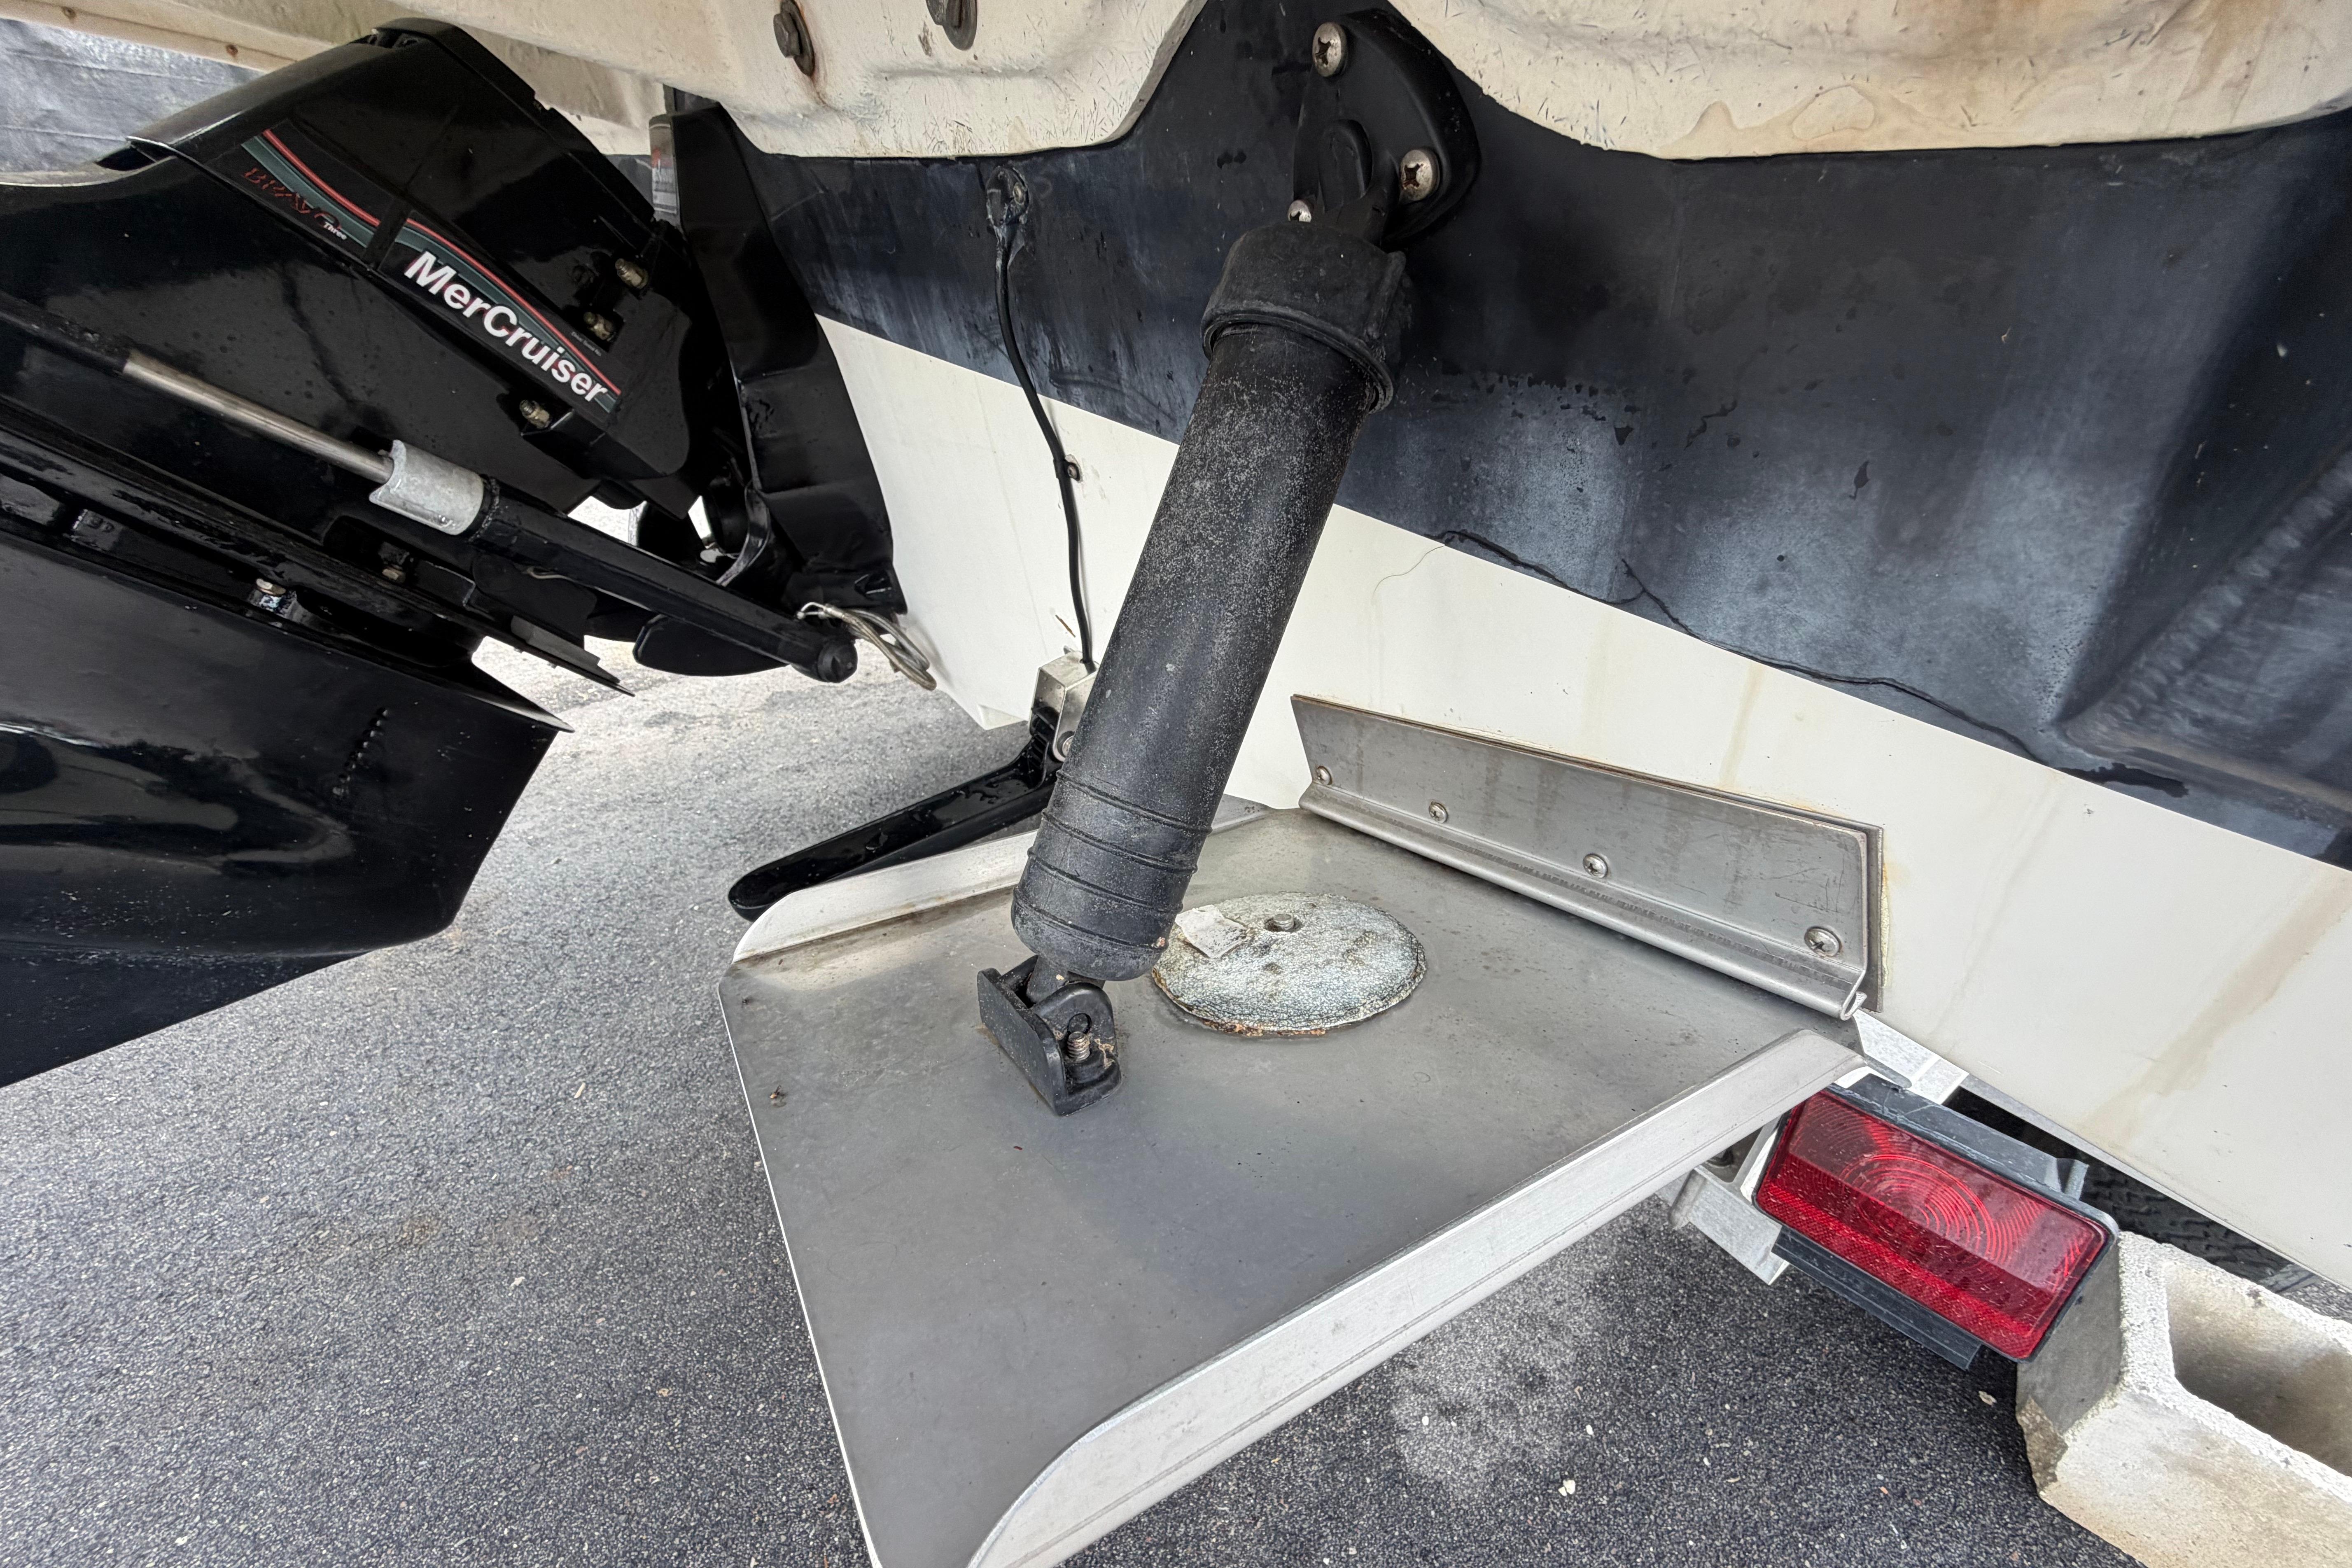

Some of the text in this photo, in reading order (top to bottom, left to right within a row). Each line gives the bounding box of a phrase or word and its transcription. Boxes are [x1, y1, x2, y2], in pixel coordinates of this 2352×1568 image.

[241, 167, 343, 231] BRAVO
[323, 221, 347, 240] Three
[404, 251, 608, 402] MerCruiser
